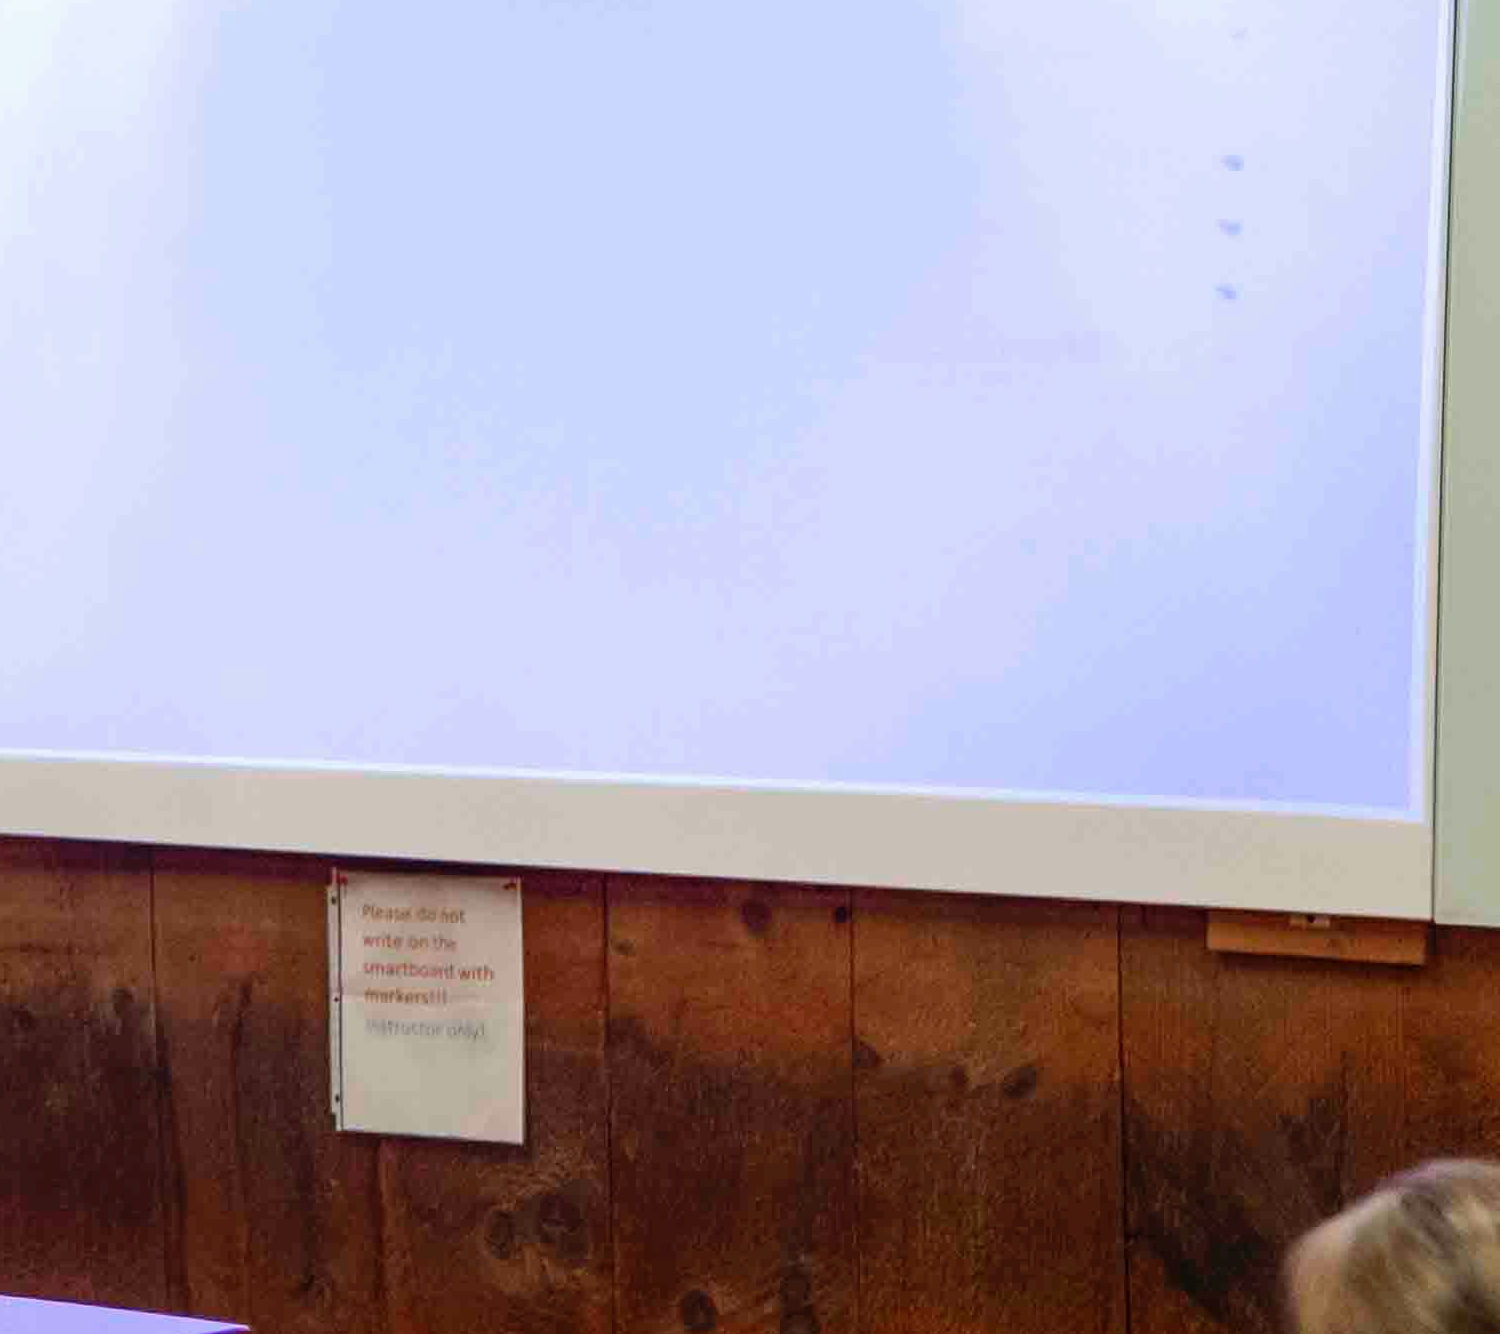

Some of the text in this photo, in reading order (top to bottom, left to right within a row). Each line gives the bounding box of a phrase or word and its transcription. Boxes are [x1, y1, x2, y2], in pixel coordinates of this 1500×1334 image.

[362, 904, 411, 923] Please
[363, 933, 403, 950] write
[433, 934, 457, 951] the
[458, 964, 495, 981] with
